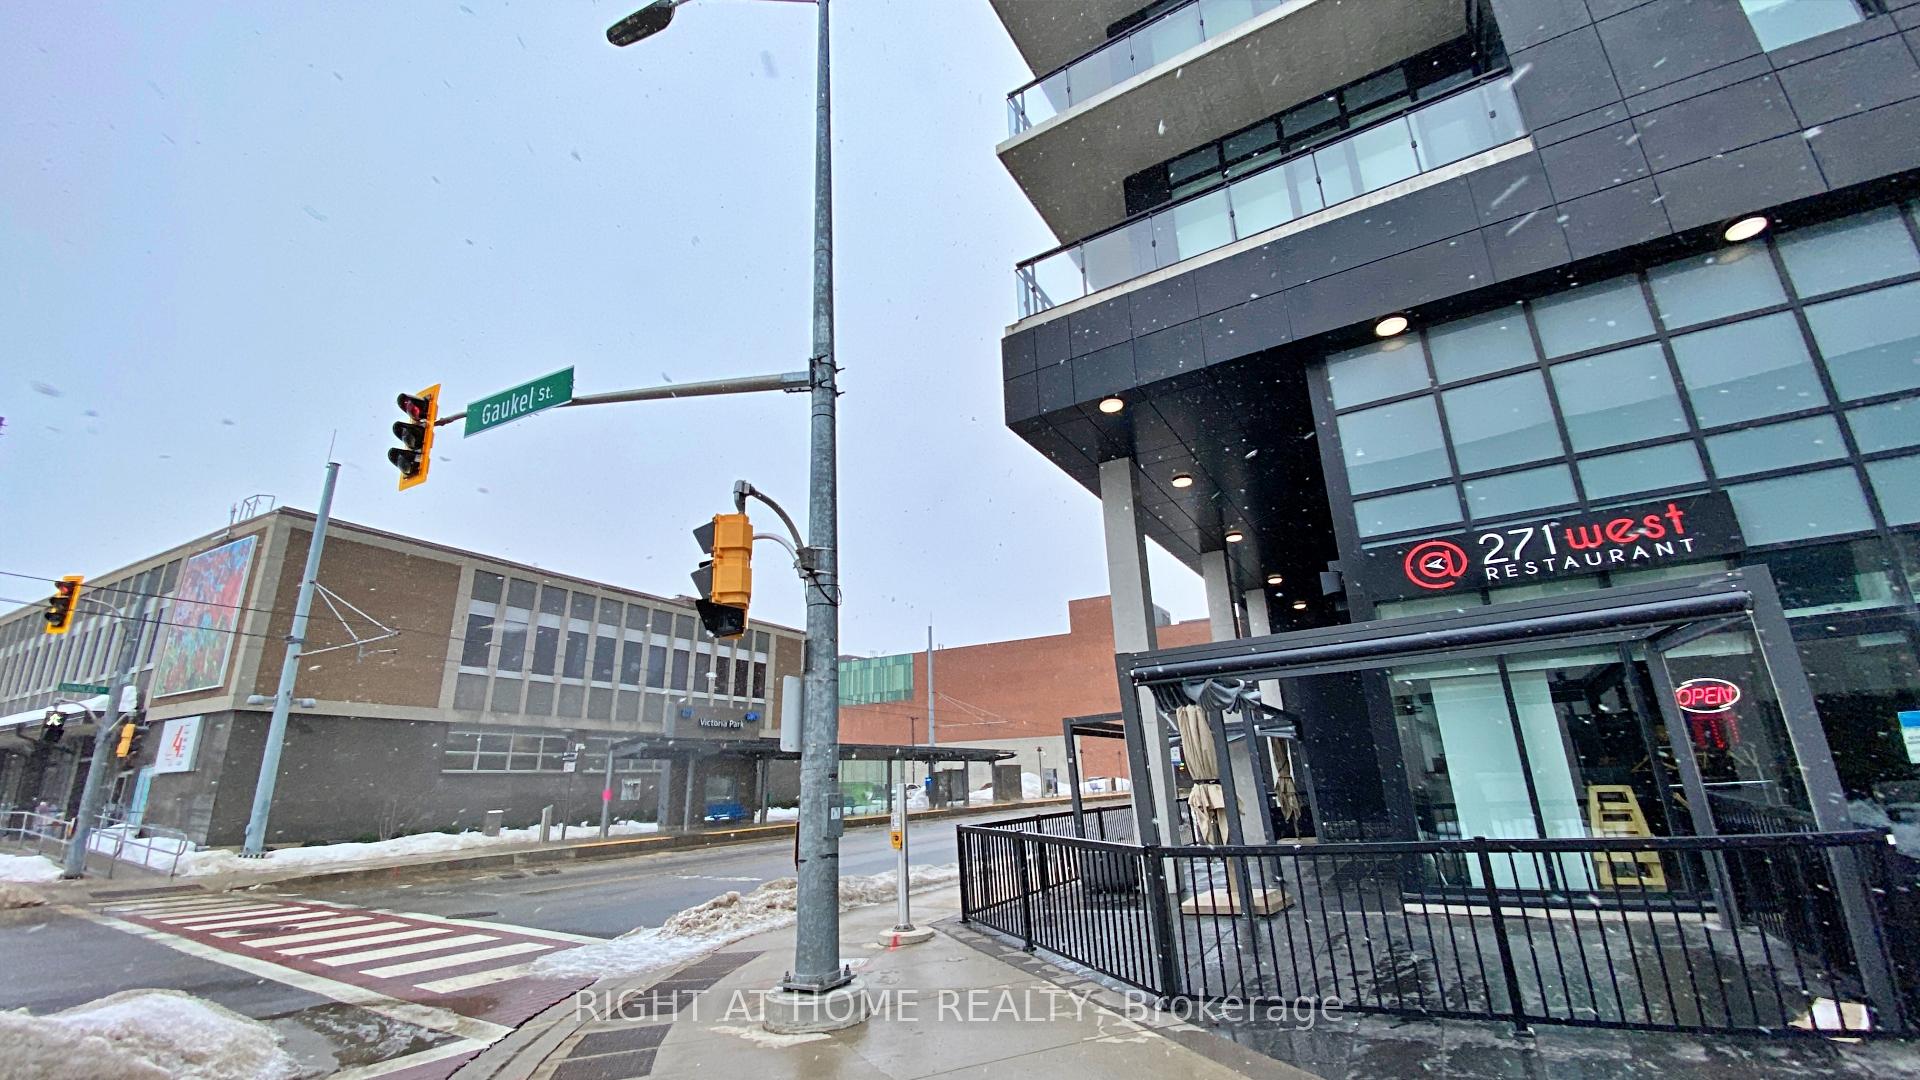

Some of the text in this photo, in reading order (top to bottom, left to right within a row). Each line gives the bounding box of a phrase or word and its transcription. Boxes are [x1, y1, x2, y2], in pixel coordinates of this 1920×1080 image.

[482, 387, 534, 425] Gaukel
[1479, 524, 1557, 565] 271
[1565, 503, 1685, 550] west
[1486, 538, 1695, 581] RESTAURANT
[1676, 686, 1733, 706] OPEN
[700, 718, 744, 729] Victoria Park
